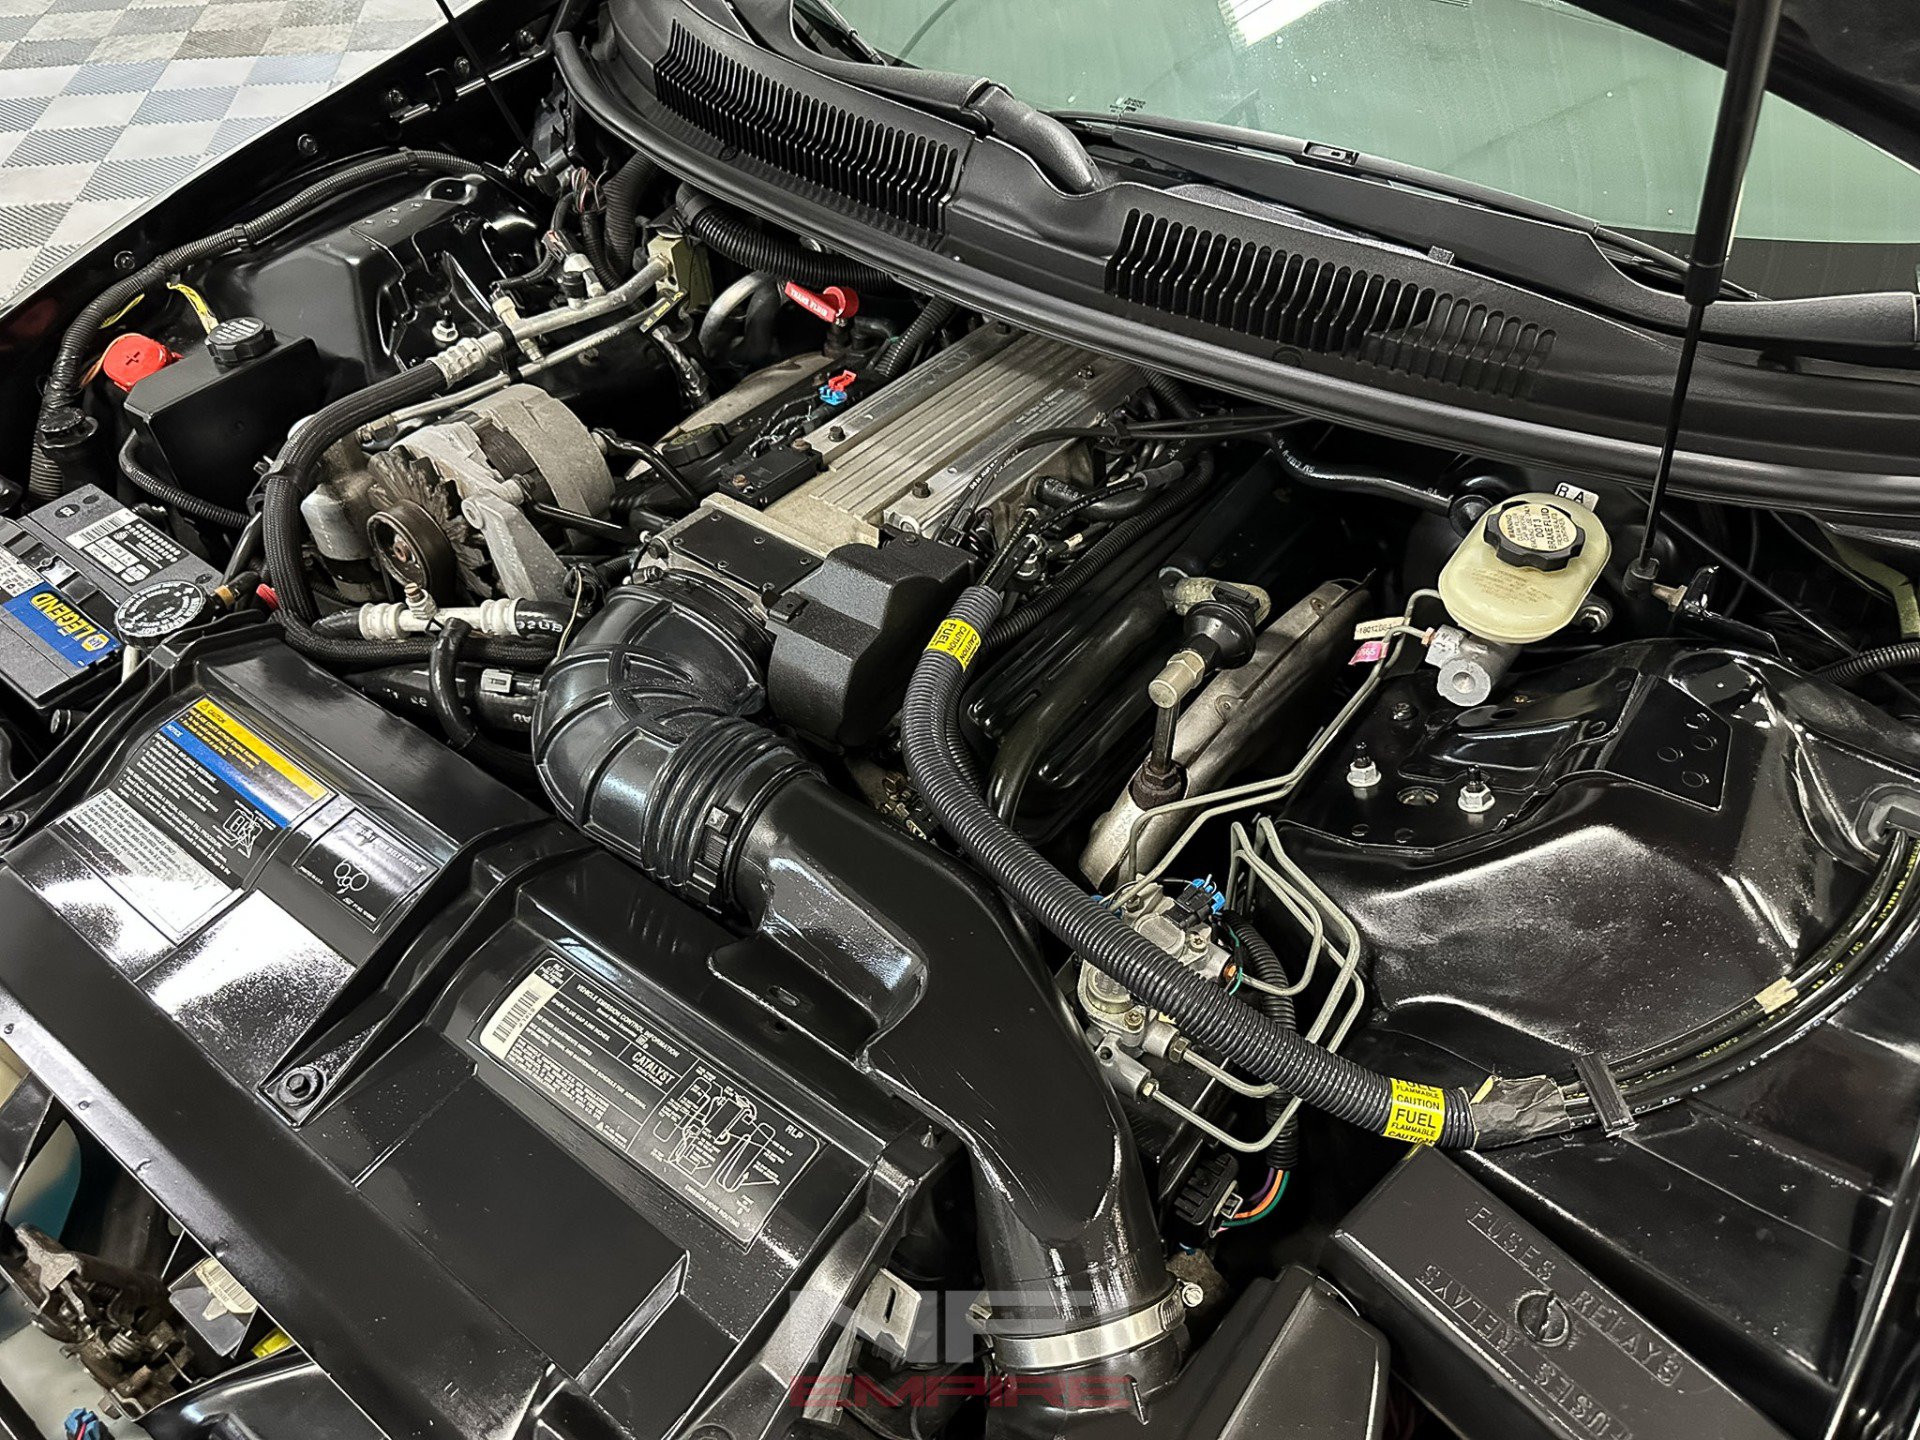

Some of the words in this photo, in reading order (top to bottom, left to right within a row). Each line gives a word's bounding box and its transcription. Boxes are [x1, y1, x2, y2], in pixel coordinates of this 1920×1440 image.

[1541, 508, 1552, 527] FLUID
[1534, 524, 1544, 538] DOT
[1544, 527, 1557, 549] BRAKE
[30, 592, 96, 641] LEGEND
[934, 622, 956, 645] FUEL
[947, 626, 967, 652] CAUTION
[960, 633, 977, 660] CAUTION
[207, 708, 226, 724] CAUTION
[166, 723, 183, 738] NOTICE
[630, 1049, 676, 1086] CATALYST
[1396, 1085, 1440, 1099] FLAMMABLE
[1396, 1094, 1440, 1110] CAUTION
[1395, 1109, 1436, 1128] FUEL
[784, 1124, 804, 1141] RLP
[1391, 1123, 1436, 1137] FLAMMABLE
[1470, 1205, 1557, 1280] FUSES
[1572, 1290, 1682, 1384] RELAYS
[1418, 1264, 1518, 1353] RELAYS
